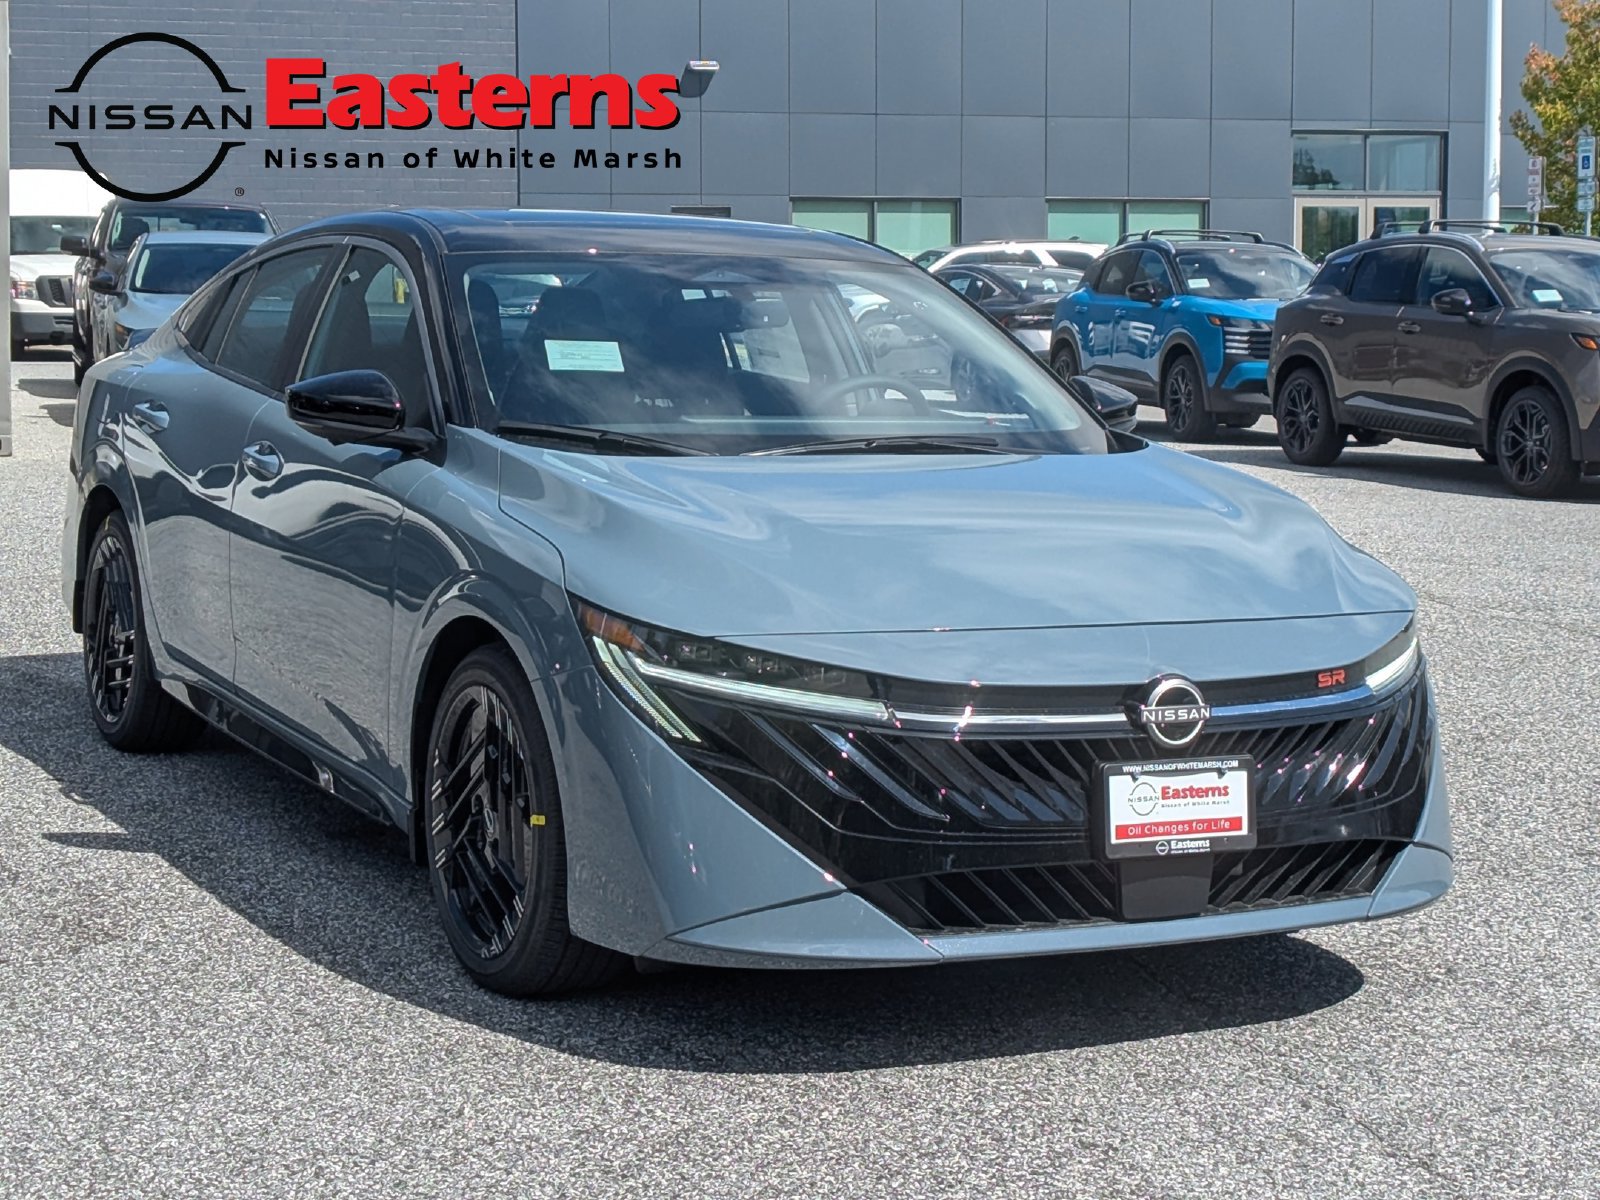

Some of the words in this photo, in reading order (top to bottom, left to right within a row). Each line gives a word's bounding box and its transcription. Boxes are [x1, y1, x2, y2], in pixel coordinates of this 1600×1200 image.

[1317, 669, 1345, 688] SR
[1143, 707, 1210, 722] NISSAN
[1127, 795, 1160, 804] NISSAN
[1161, 785, 1230, 801] Easterns
[1127, 826, 1141, 836] Oil
[1144, 823, 1190, 835] Changes
[1192, 821, 1208, 831] for
[1211, 819, 1231, 830] Life
[1170, 839, 1210, 850] Easterns
